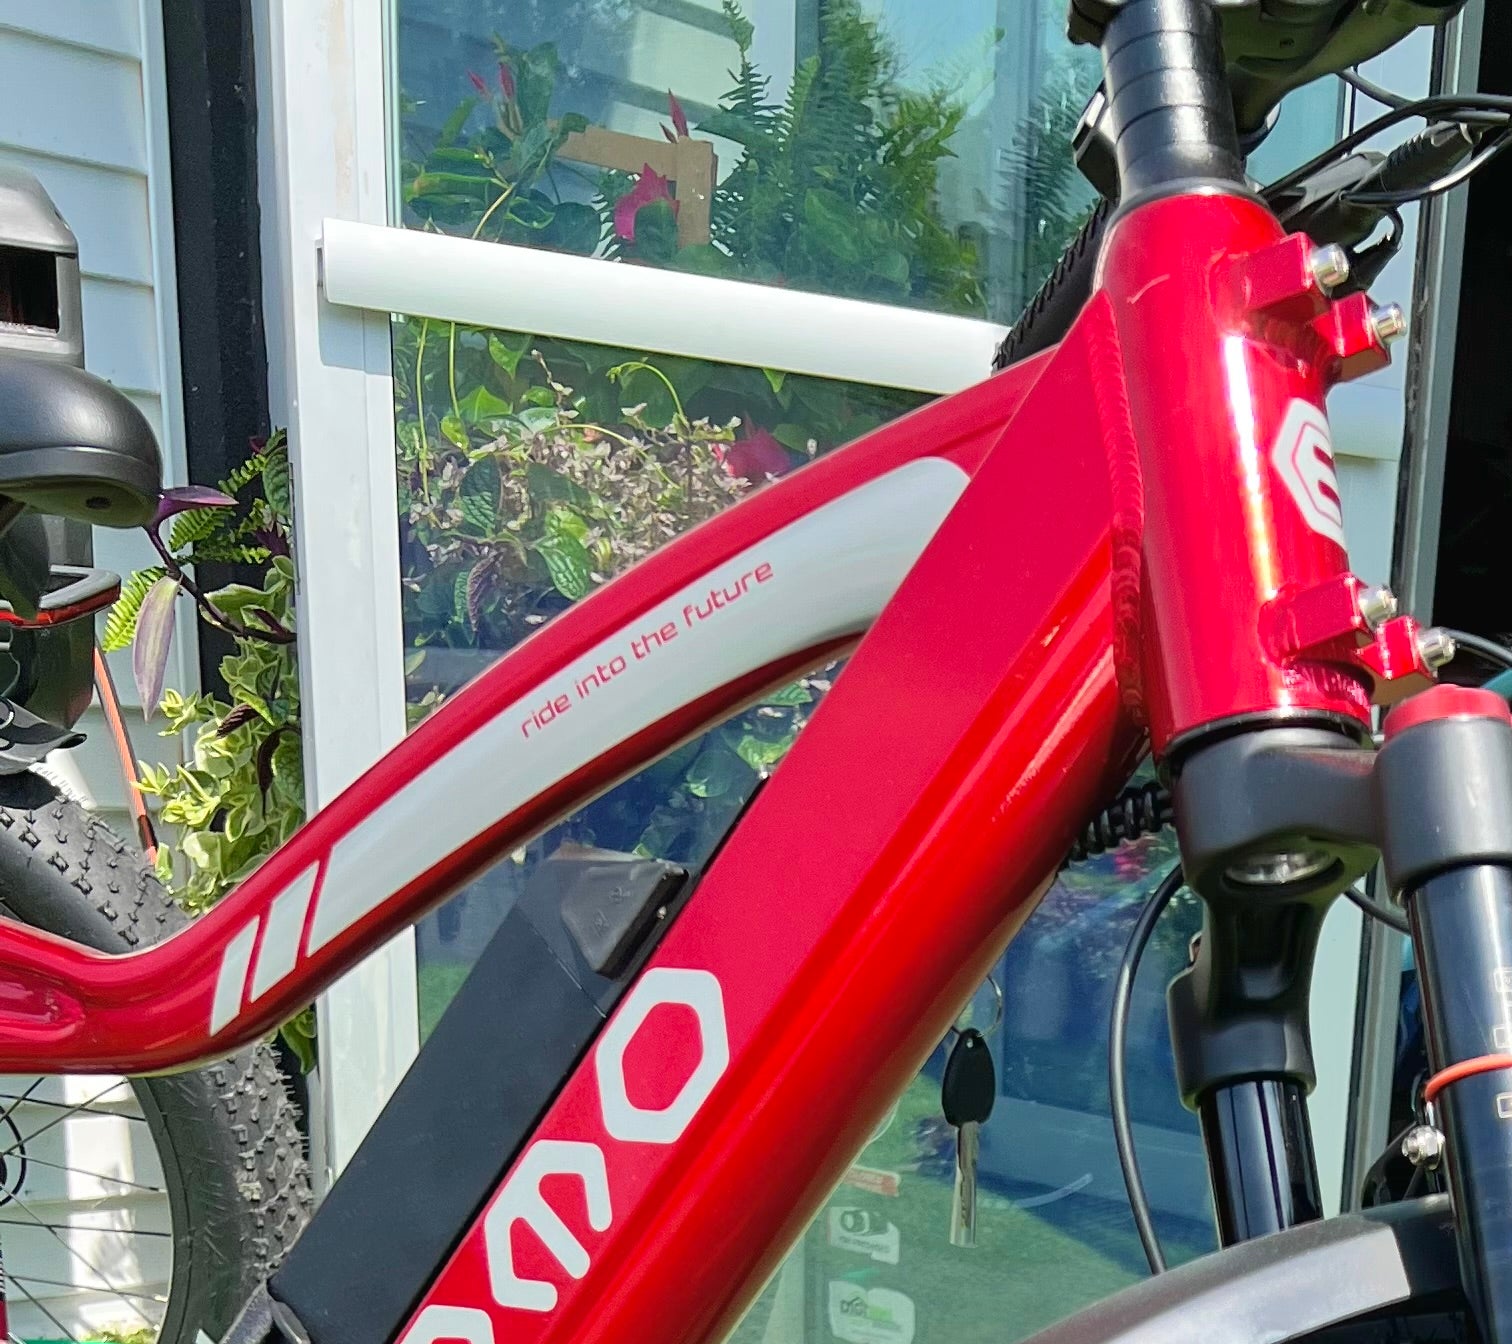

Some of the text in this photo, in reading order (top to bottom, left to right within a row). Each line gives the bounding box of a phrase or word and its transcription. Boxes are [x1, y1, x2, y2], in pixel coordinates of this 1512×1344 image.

[520, 562, 773, 738] ride into the future
